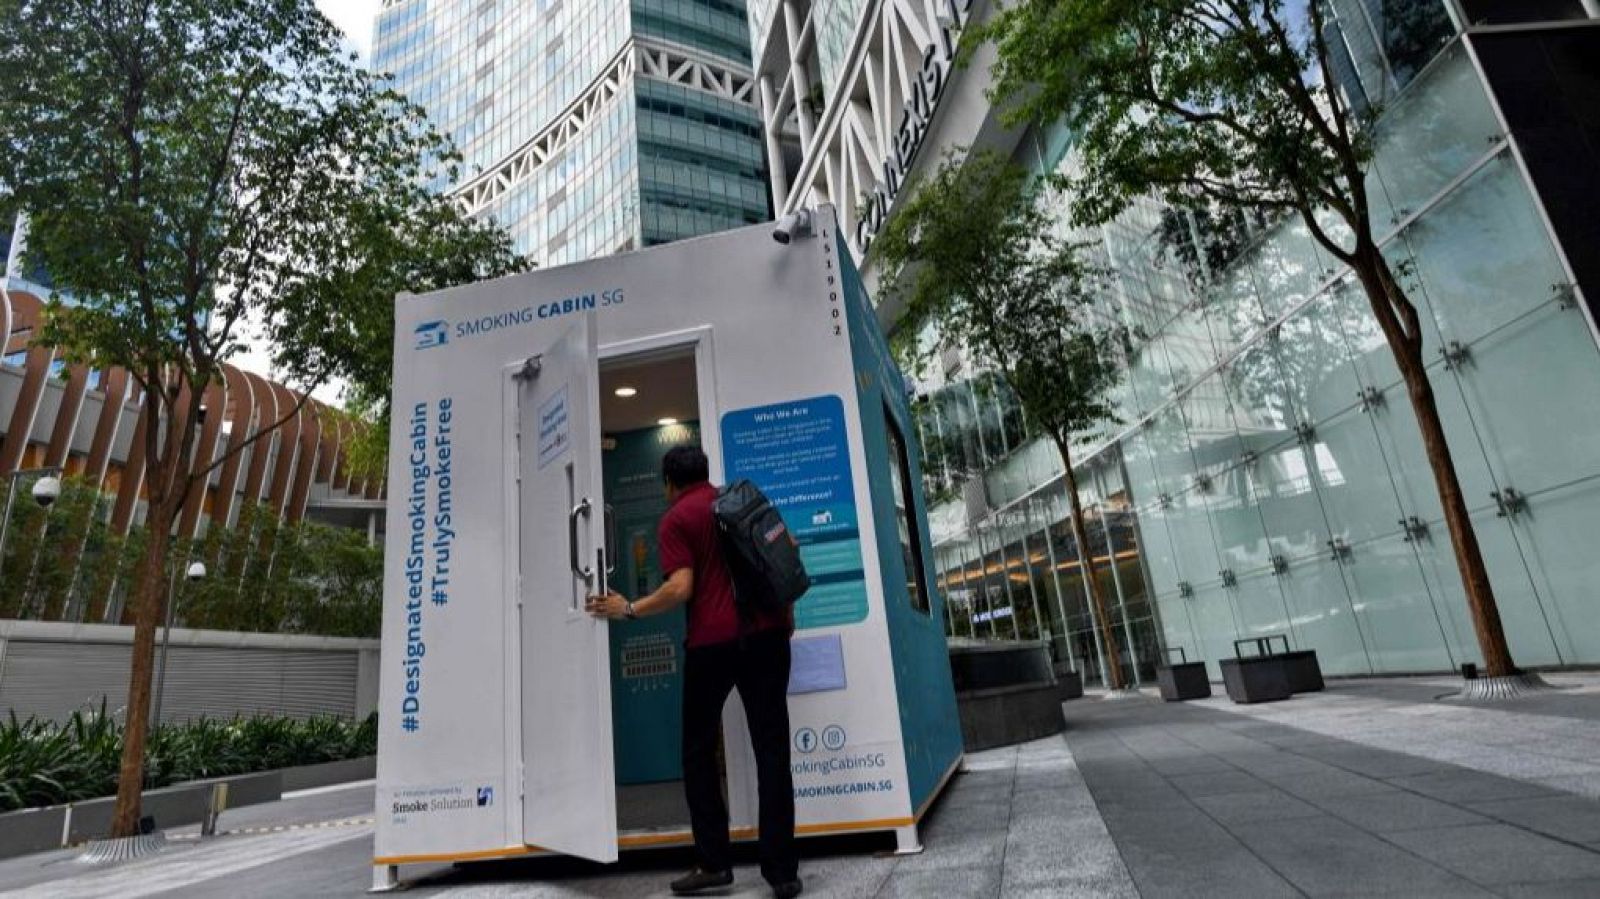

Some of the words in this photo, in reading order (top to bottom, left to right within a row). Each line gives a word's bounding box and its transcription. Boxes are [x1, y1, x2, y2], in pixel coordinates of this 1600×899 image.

[456, 309, 533, 338] SMOKING
[537, 294, 596, 319] CABIN
[602, 288, 624, 306] SG
[753, 412, 774, 424] Who
[776, 410, 790, 420] We
[793, 406, 809, 416] Are
[432, 397, 456, 607] #TrulySmokeFree
[402, 402, 431, 732] #DesignatedSmokingCabin
[790, 752, 886, 775] okingCabinSG
[391, 800, 428, 814] Smoke
[430, 797, 473, 812] Solution
